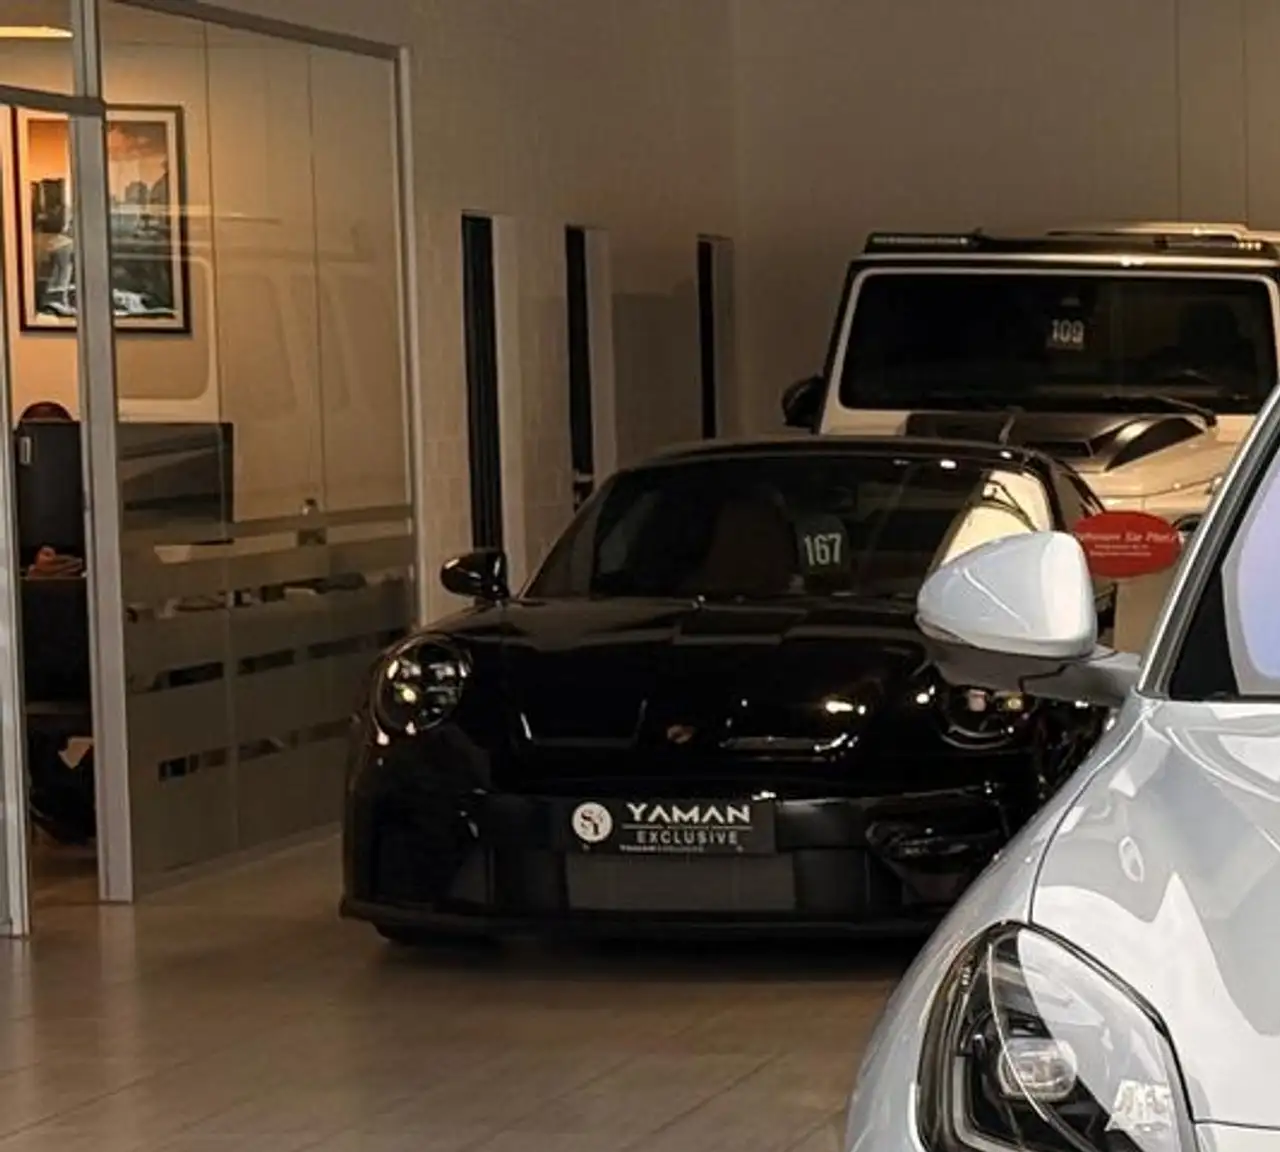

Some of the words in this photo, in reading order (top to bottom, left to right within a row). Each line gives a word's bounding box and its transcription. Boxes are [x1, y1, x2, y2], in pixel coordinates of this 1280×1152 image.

[1052, 319, 1084, 343] 109
[804, 533, 842, 566] 167
[626, 803, 750, 824] YAMAN
[636, 830, 738, 845] EXCLUSIVE
